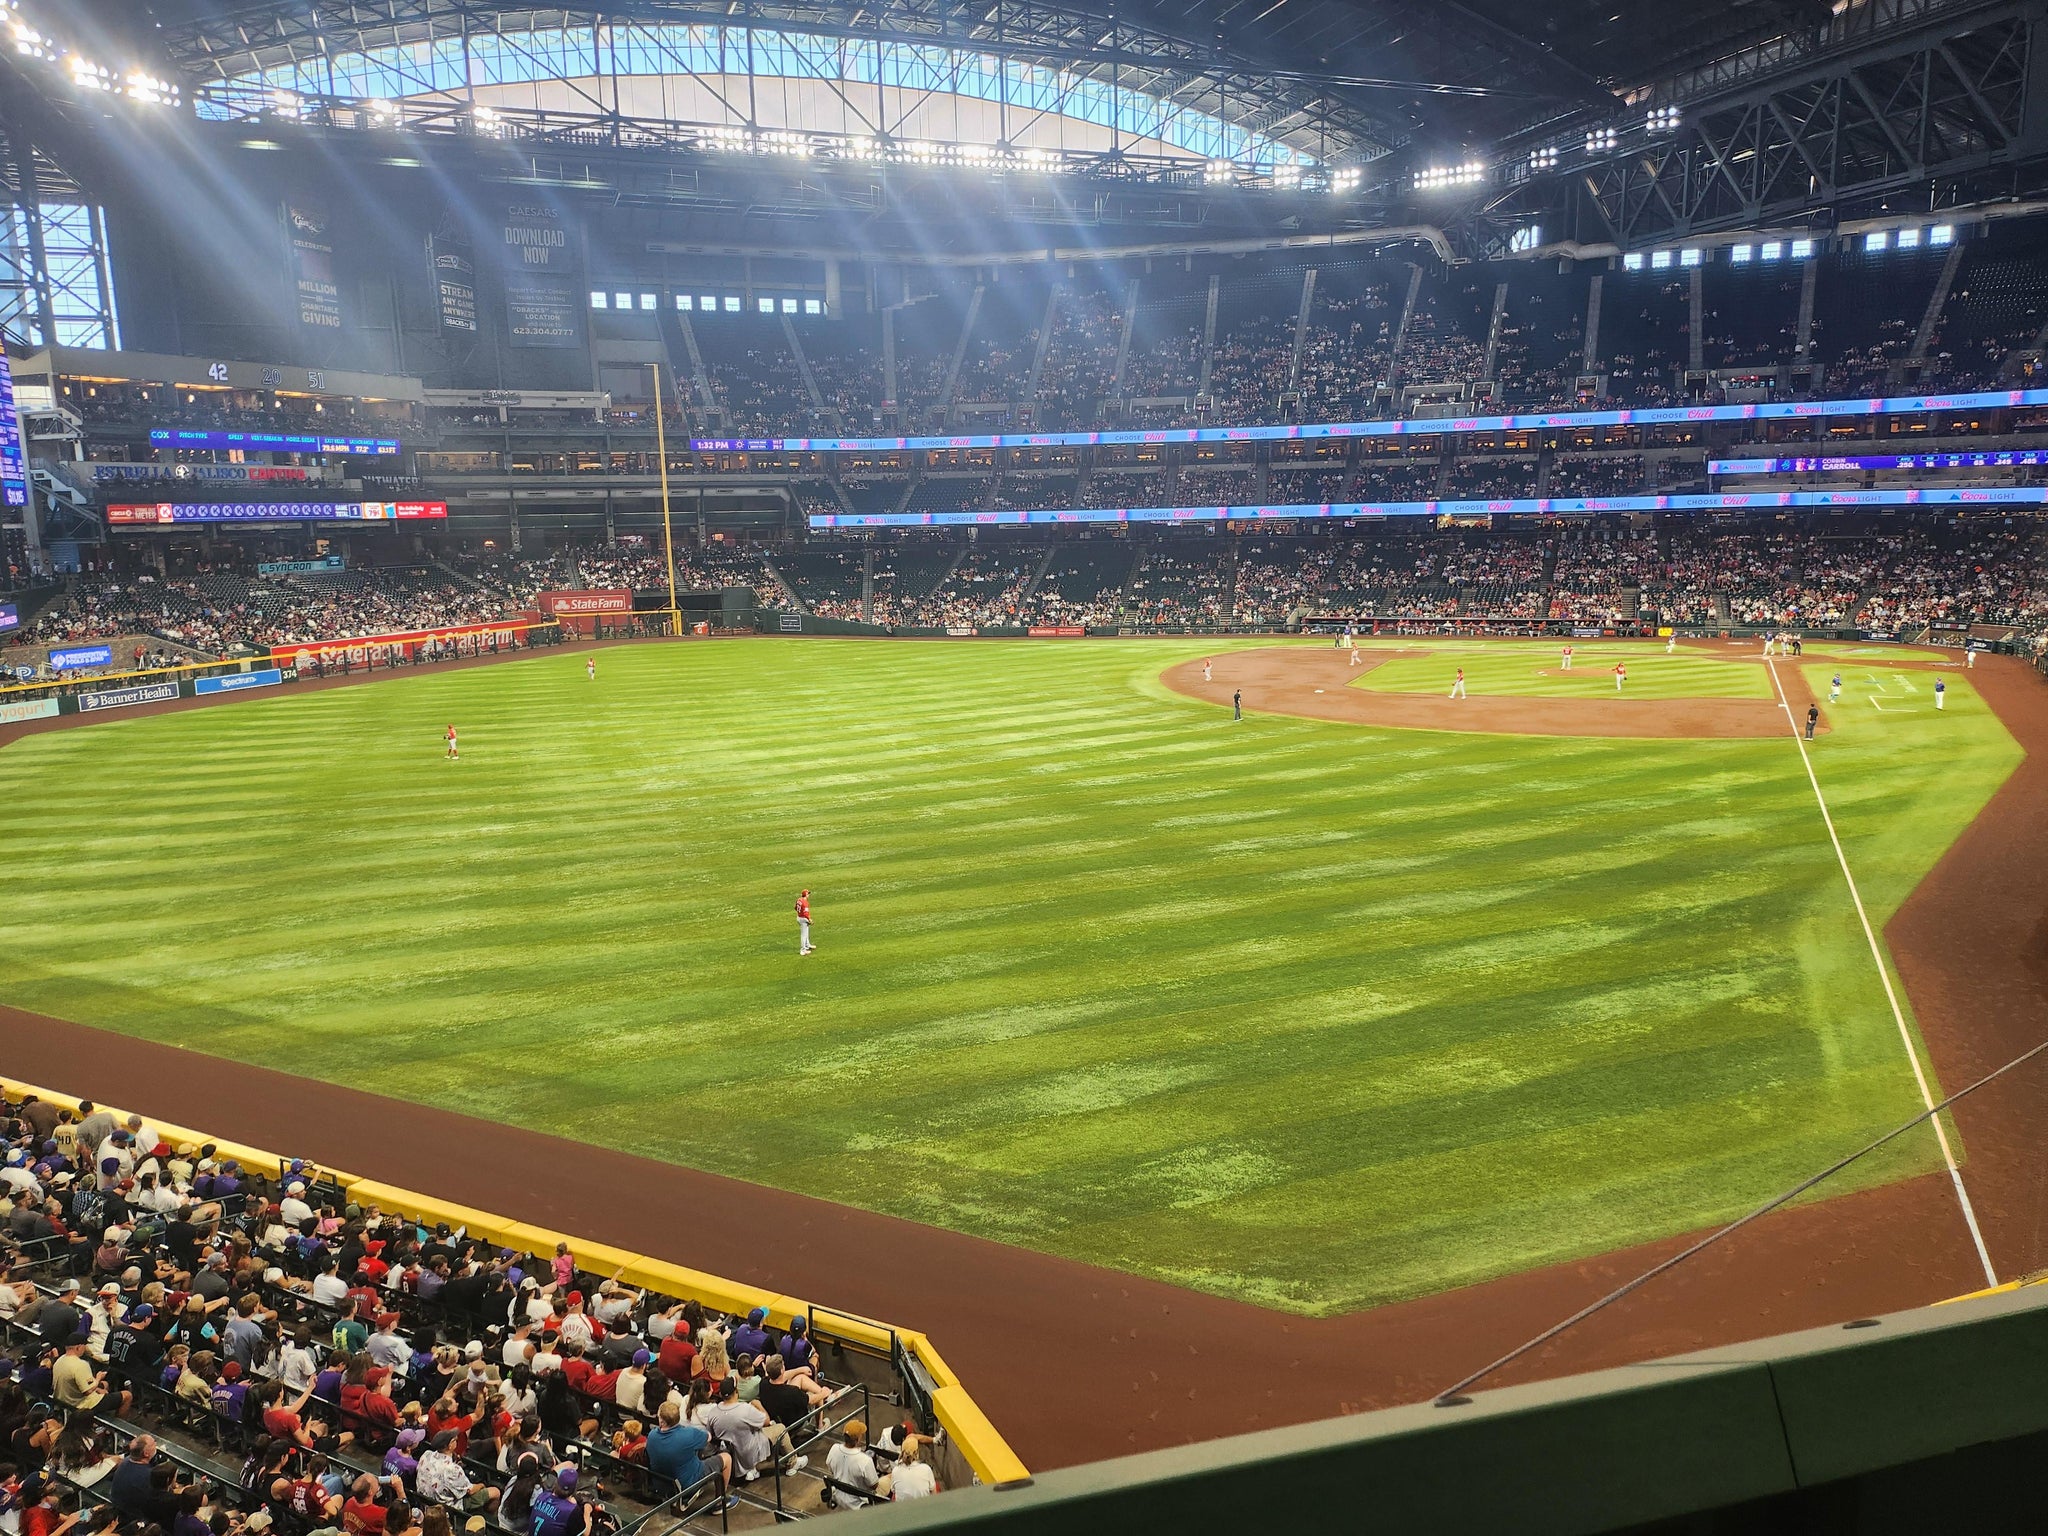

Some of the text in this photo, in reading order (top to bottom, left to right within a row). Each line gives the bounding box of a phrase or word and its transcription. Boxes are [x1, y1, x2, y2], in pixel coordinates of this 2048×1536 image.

[508, 206, 558, 218] CAESARS
[504, 228, 564, 247] DOWNLOAD
[524, 246, 550, 264] NOW
[298, 280, 337, 296] MILLION
[440, 284, 474, 300] STREAM
[300, 302, 339, 314] CHARITABLE
[442, 297, 475, 310] ANY GAME
[443, 307, 476, 318] ANYWHERE
[302, 312, 340, 327] GIVING
[513, 328, 574, 336] 623.304.0777
[208, 363, 228, 381] 42
[262, 368, 282, 386] 20
[308, 371, 325, 390] 51
[1924, 398, 1952, 408] Coors
[1687, 408, 1716, 419] Chill
[1794, 405, 1820, 414] Coors
[1453, 420, 1478, 429] Chill
[1548, 416, 1571, 425] Coors
[1330, 426, 1350, 434] Coors
[950, 438, 971, 446] Chill
[1030, 436, 1050, 444] Coors
[1144, 433, 1167, 441] Chill
[95, 466, 172, 479] ESTRELLA
[248, 468, 306, 480] CANTINA
[1722, 495, 1750, 505] Chill
[1831, 494, 1856, 503] Coors
[1961, 491, 1989, 500] Coors
[1361, 506, 1382, 514] Coors
[1487, 502, 1513, 511] Chill
[1585, 500, 1608, 509] Coors
[352, 506, 357, 515] 1
[1173, 510, 1196, 518] Chill
[976, 513, 998, 522] Chill
[1057, 513, 1077, 521] Coors
[269, 563, 311, 572] SYNCRON
[571, 598, 623, 610] State Farm
[445, 628, 512, 649] State Farm
[320, 642, 404, 665] State Farm
[283, 670, 297, 679] 374
[221, 676, 255, 688] Spectrum
[100, 686, 172, 706] Banner Health
[3, 702, 45, 718] yogurt
[113, 1330, 136, 1344] JOHNSON
[111, 1341, 129, 1362] 51
[534, 1500, 560, 1521] CARROLL
[534, 1516, 544, 1536] 7
